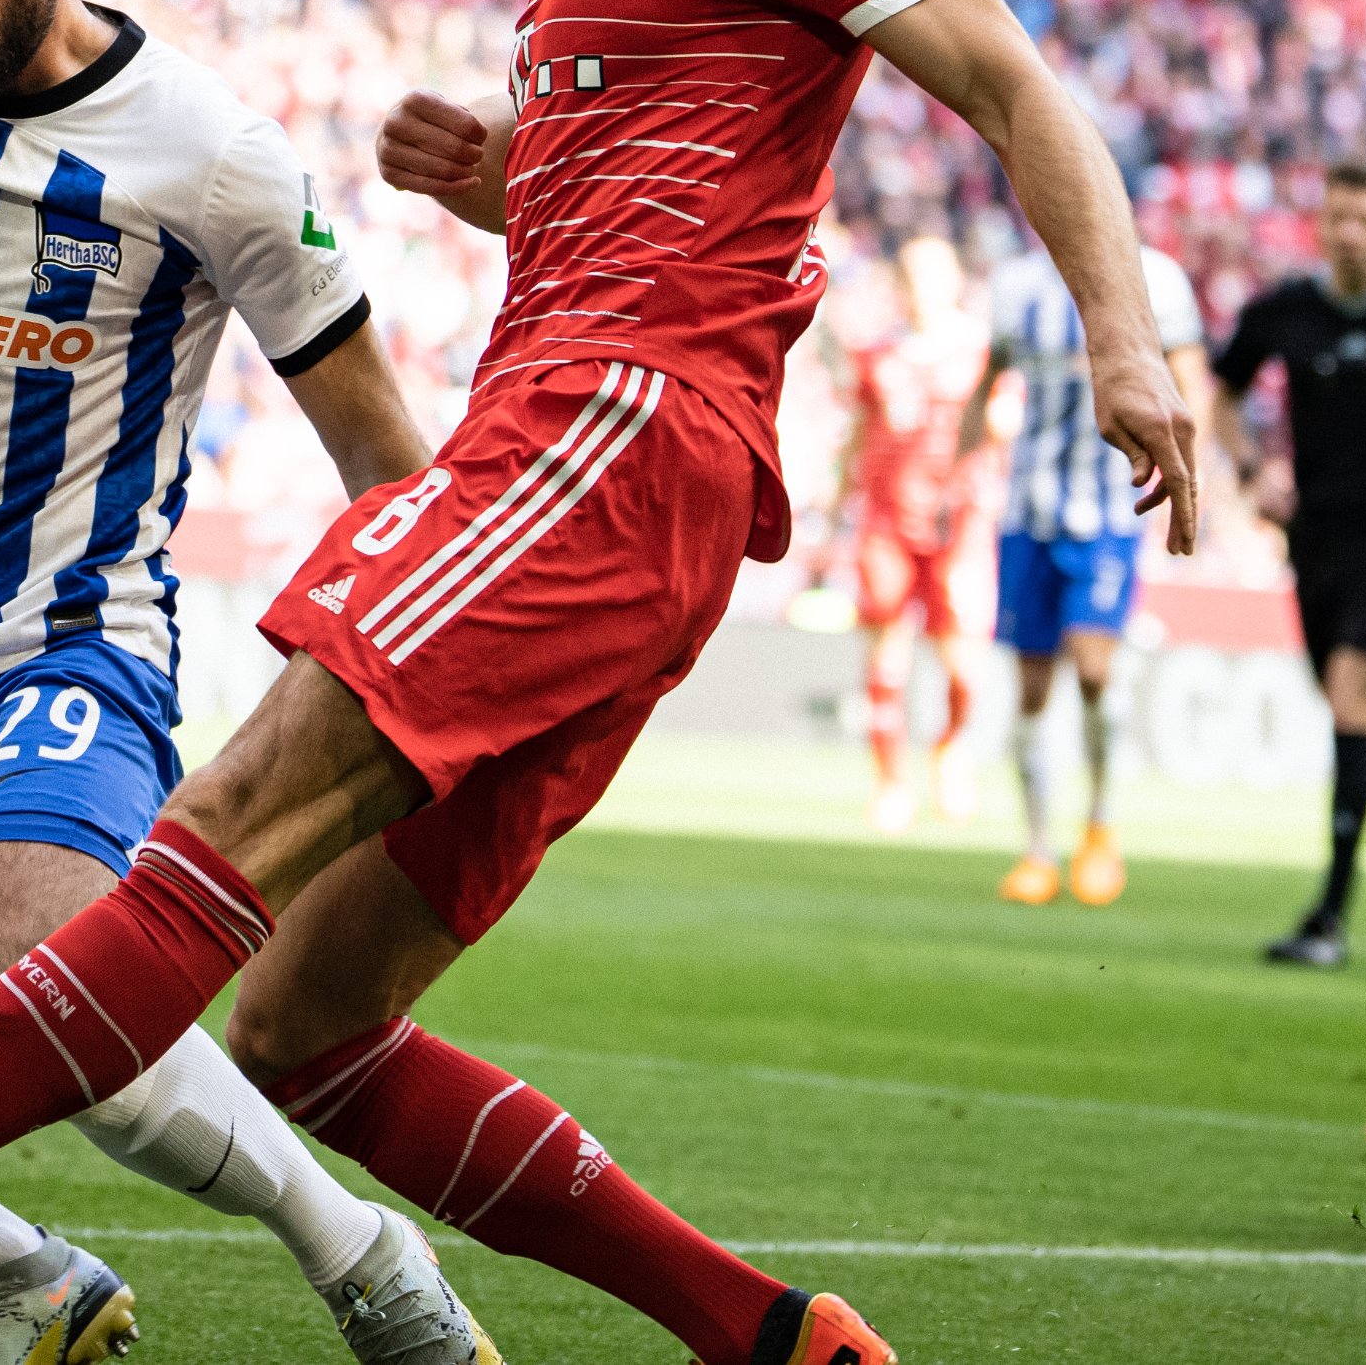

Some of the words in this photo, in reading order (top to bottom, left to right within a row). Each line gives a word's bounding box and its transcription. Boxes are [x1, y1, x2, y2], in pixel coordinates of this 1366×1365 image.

[351, 467, 452, 556] 8
[307, 587, 345, 615] adidas
[17, 954, 76, 1022] YERN
